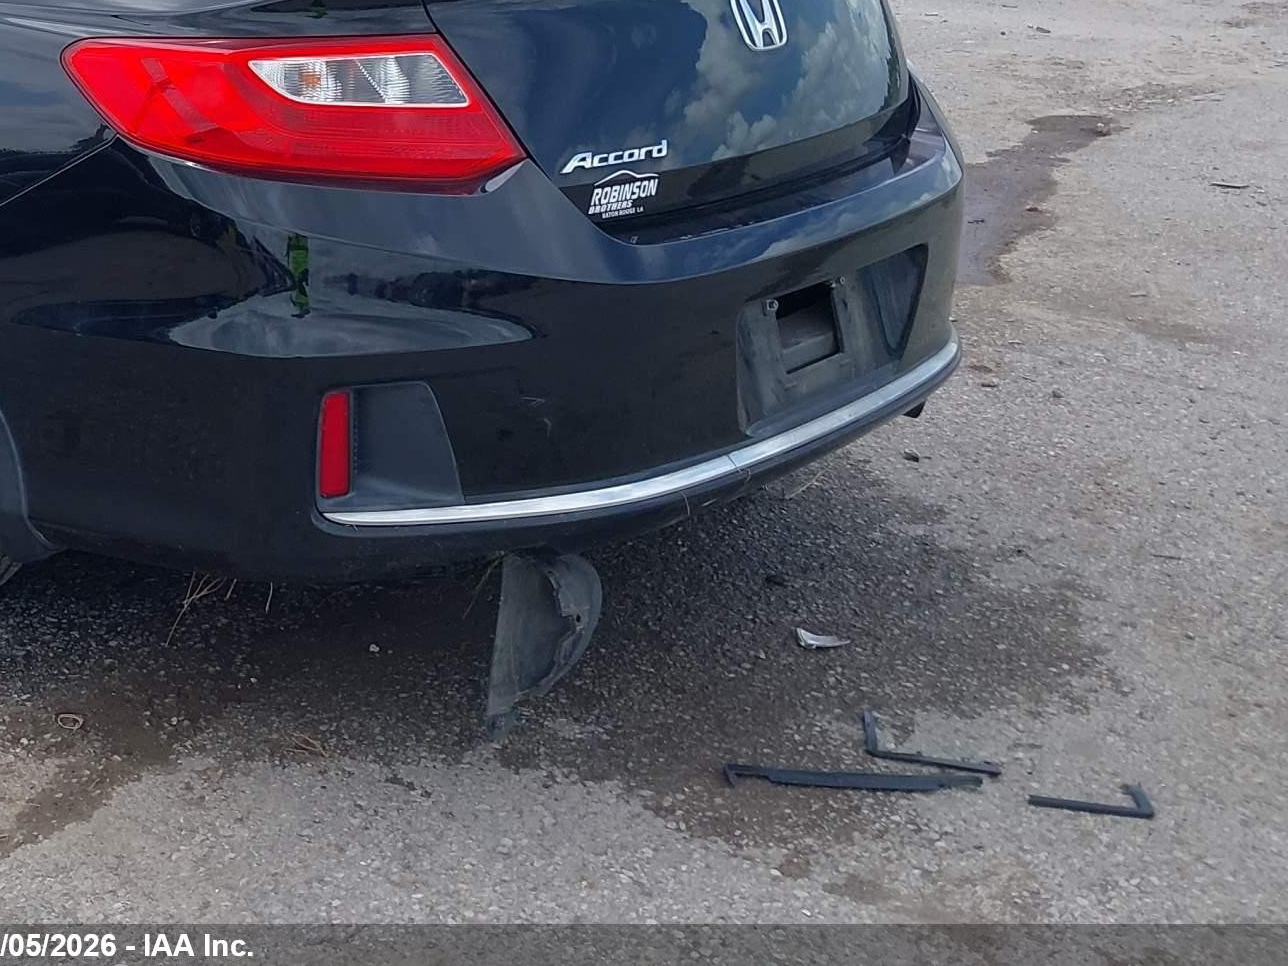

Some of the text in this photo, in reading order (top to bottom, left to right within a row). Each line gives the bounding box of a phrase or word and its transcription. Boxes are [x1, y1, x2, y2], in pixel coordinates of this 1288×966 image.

[560, 139, 668, 173] Accord
[590, 179, 658, 206] ROBINSON
[588, 199, 634, 215] BROTHERS
